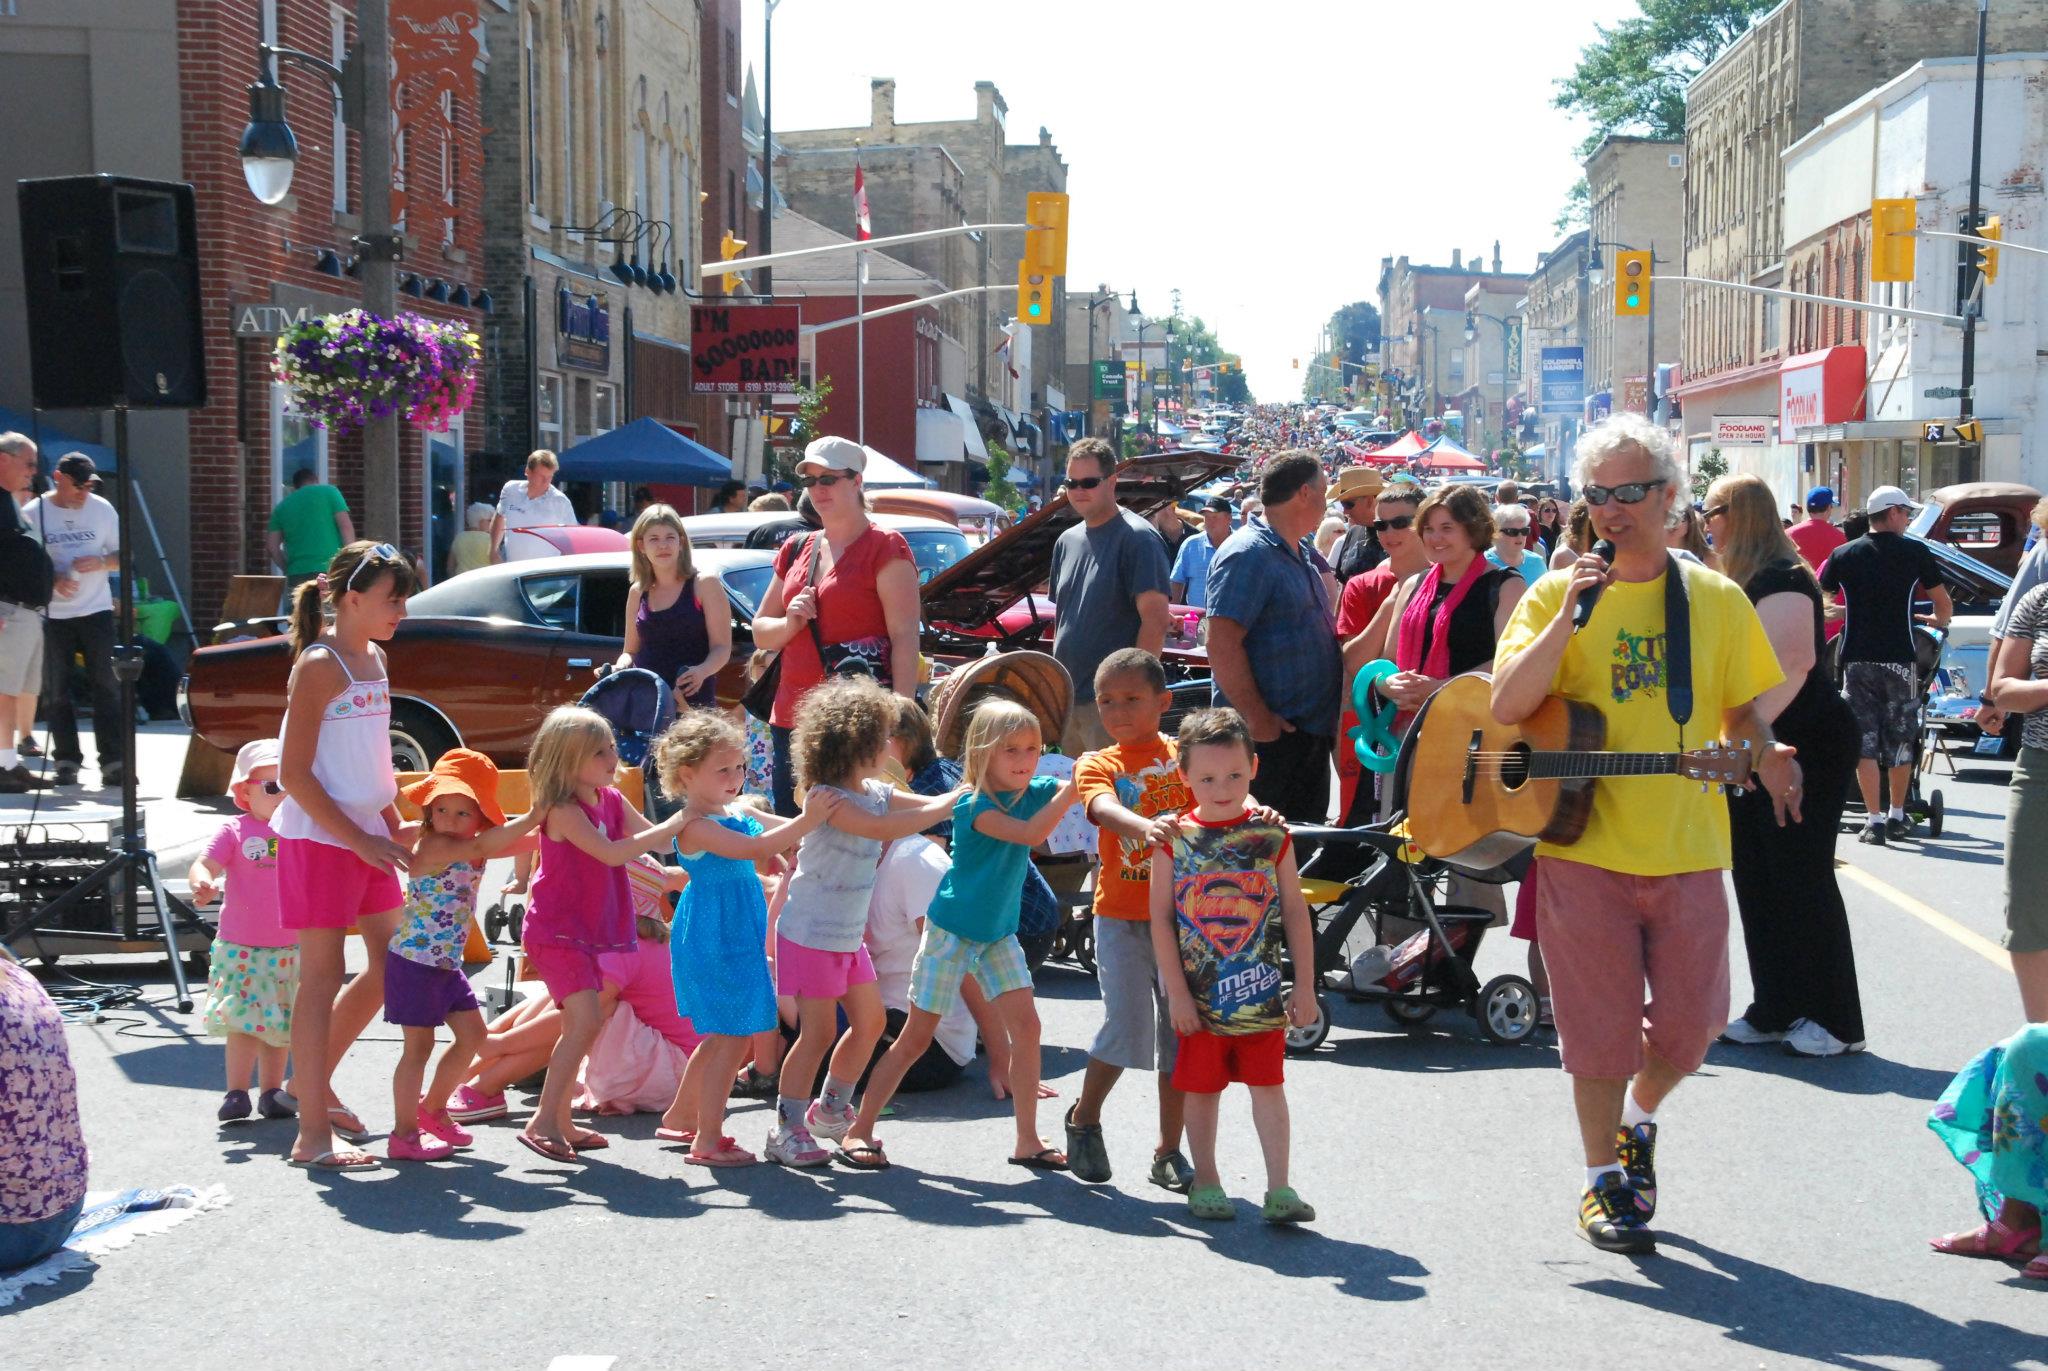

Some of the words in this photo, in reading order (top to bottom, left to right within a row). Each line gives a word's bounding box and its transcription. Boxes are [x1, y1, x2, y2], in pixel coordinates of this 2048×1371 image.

[236, 307, 308, 332] ATM
[694, 308, 729, 333] I'M
[694, 383, 714, 392] ADULT
[718, 383, 739, 392] STORE
[744, 382, 762, 392] (519)
[1786, 387, 1817, 426] FOODLAND
[1719, 423, 1765, 432] FOODLAND
[1218, 962, 1267, 996] MAN
[1219, 992, 1233, 1005] OF
